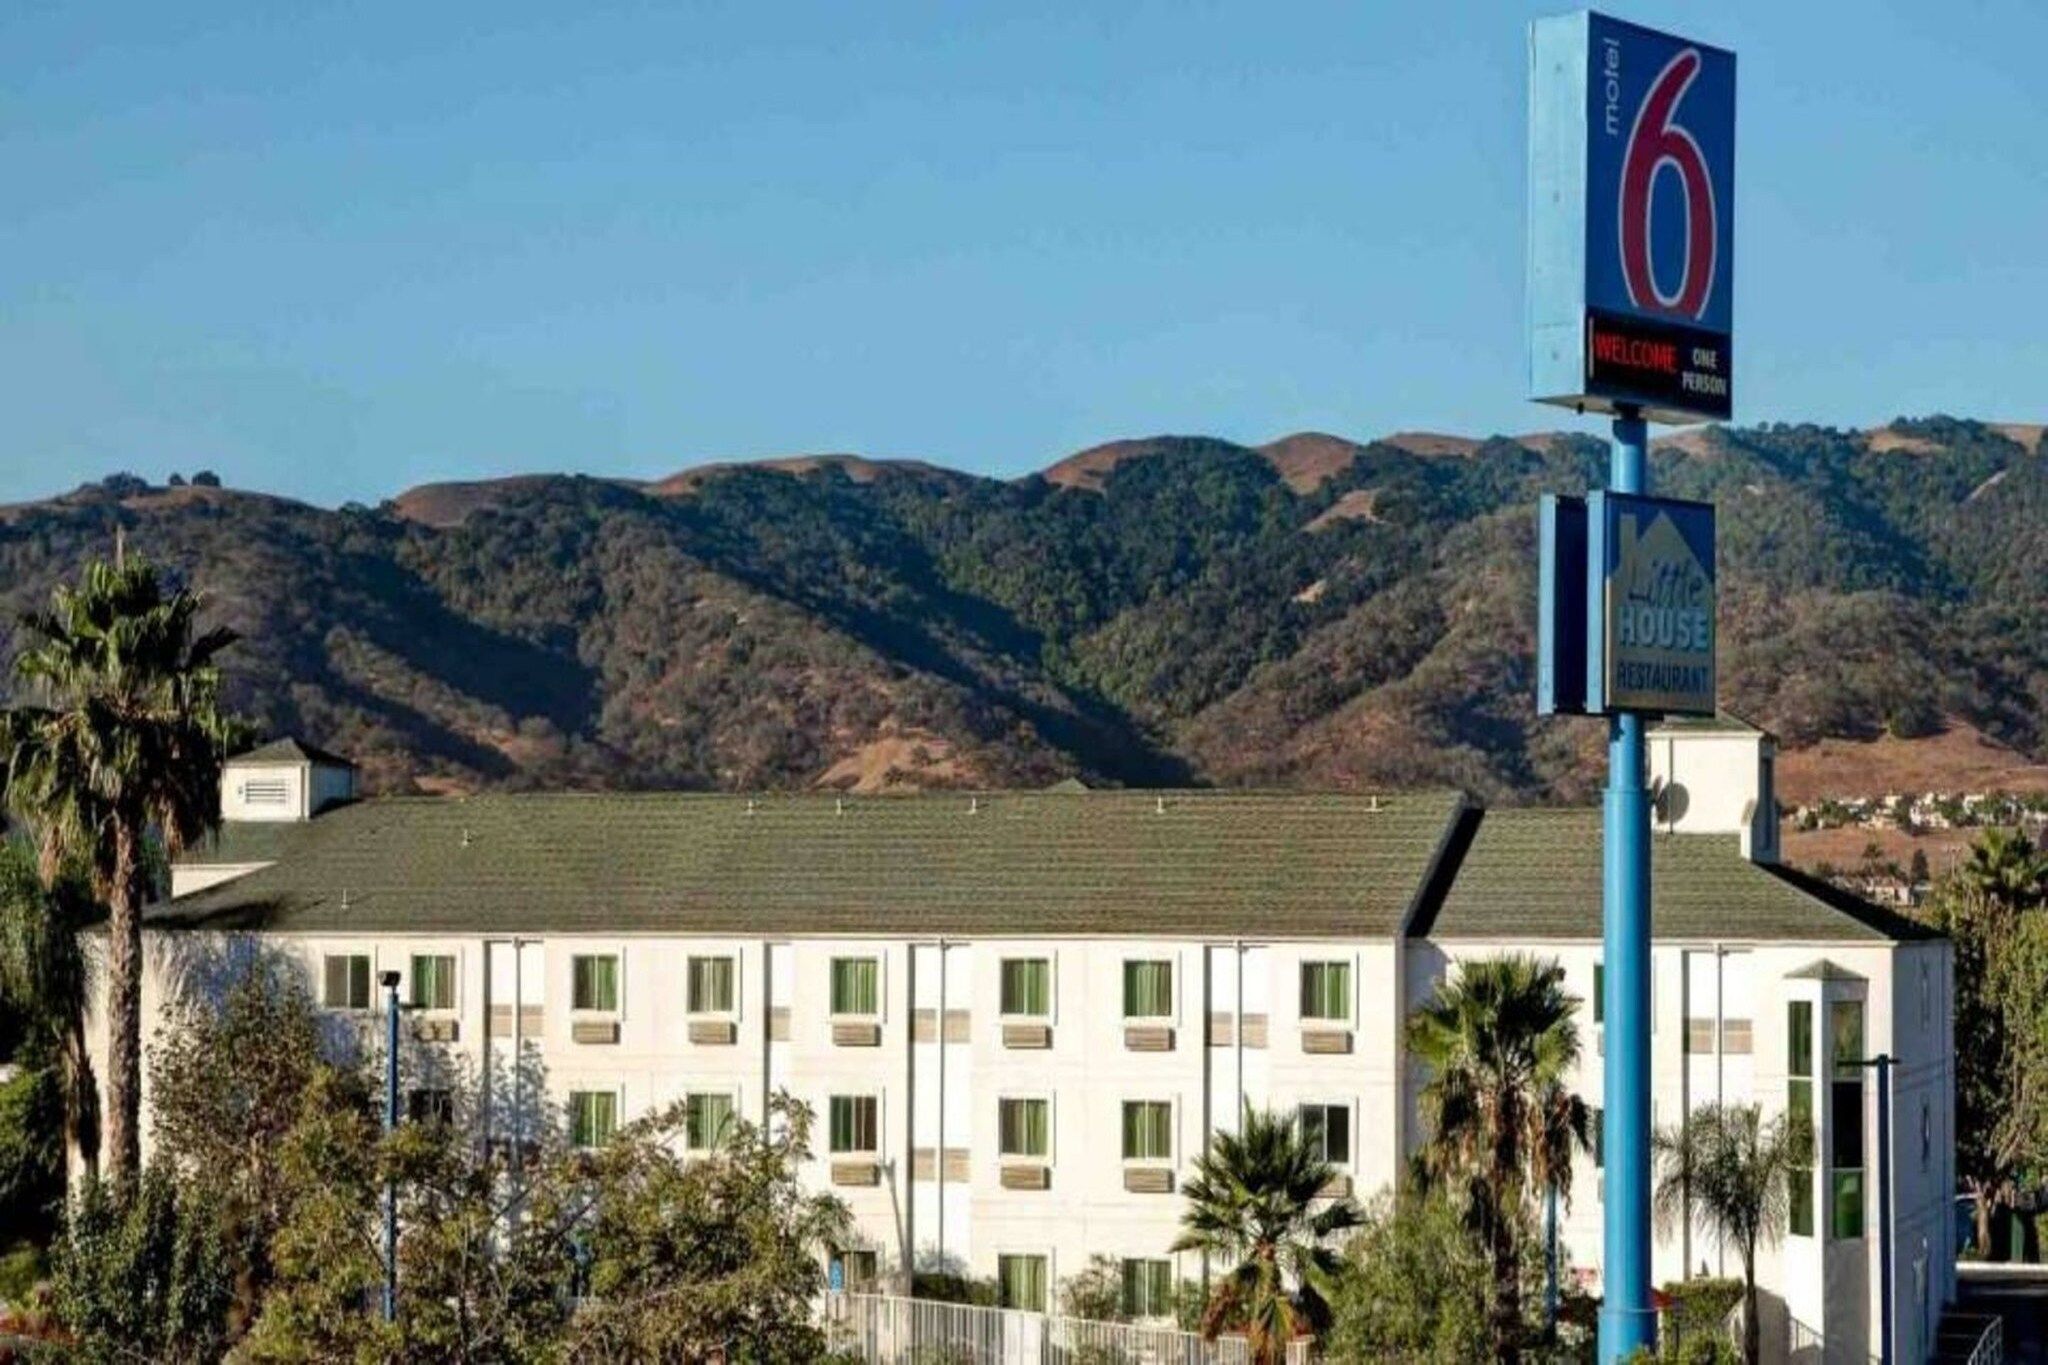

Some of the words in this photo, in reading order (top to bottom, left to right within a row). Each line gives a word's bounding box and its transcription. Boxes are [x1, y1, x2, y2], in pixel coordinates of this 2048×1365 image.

[1603, 37, 1620, 136] motel
[1619, 49, 1716, 319] 6
[1594, 330, 1677, 374] WELCOME
[1692, 347, 1718, 369] ONE
[1681, 370, 1726, 396] PERSON
[1620, 606, 1708, 649] HOUSE
[1617, 661, 1709, 692] RESTAURANT
